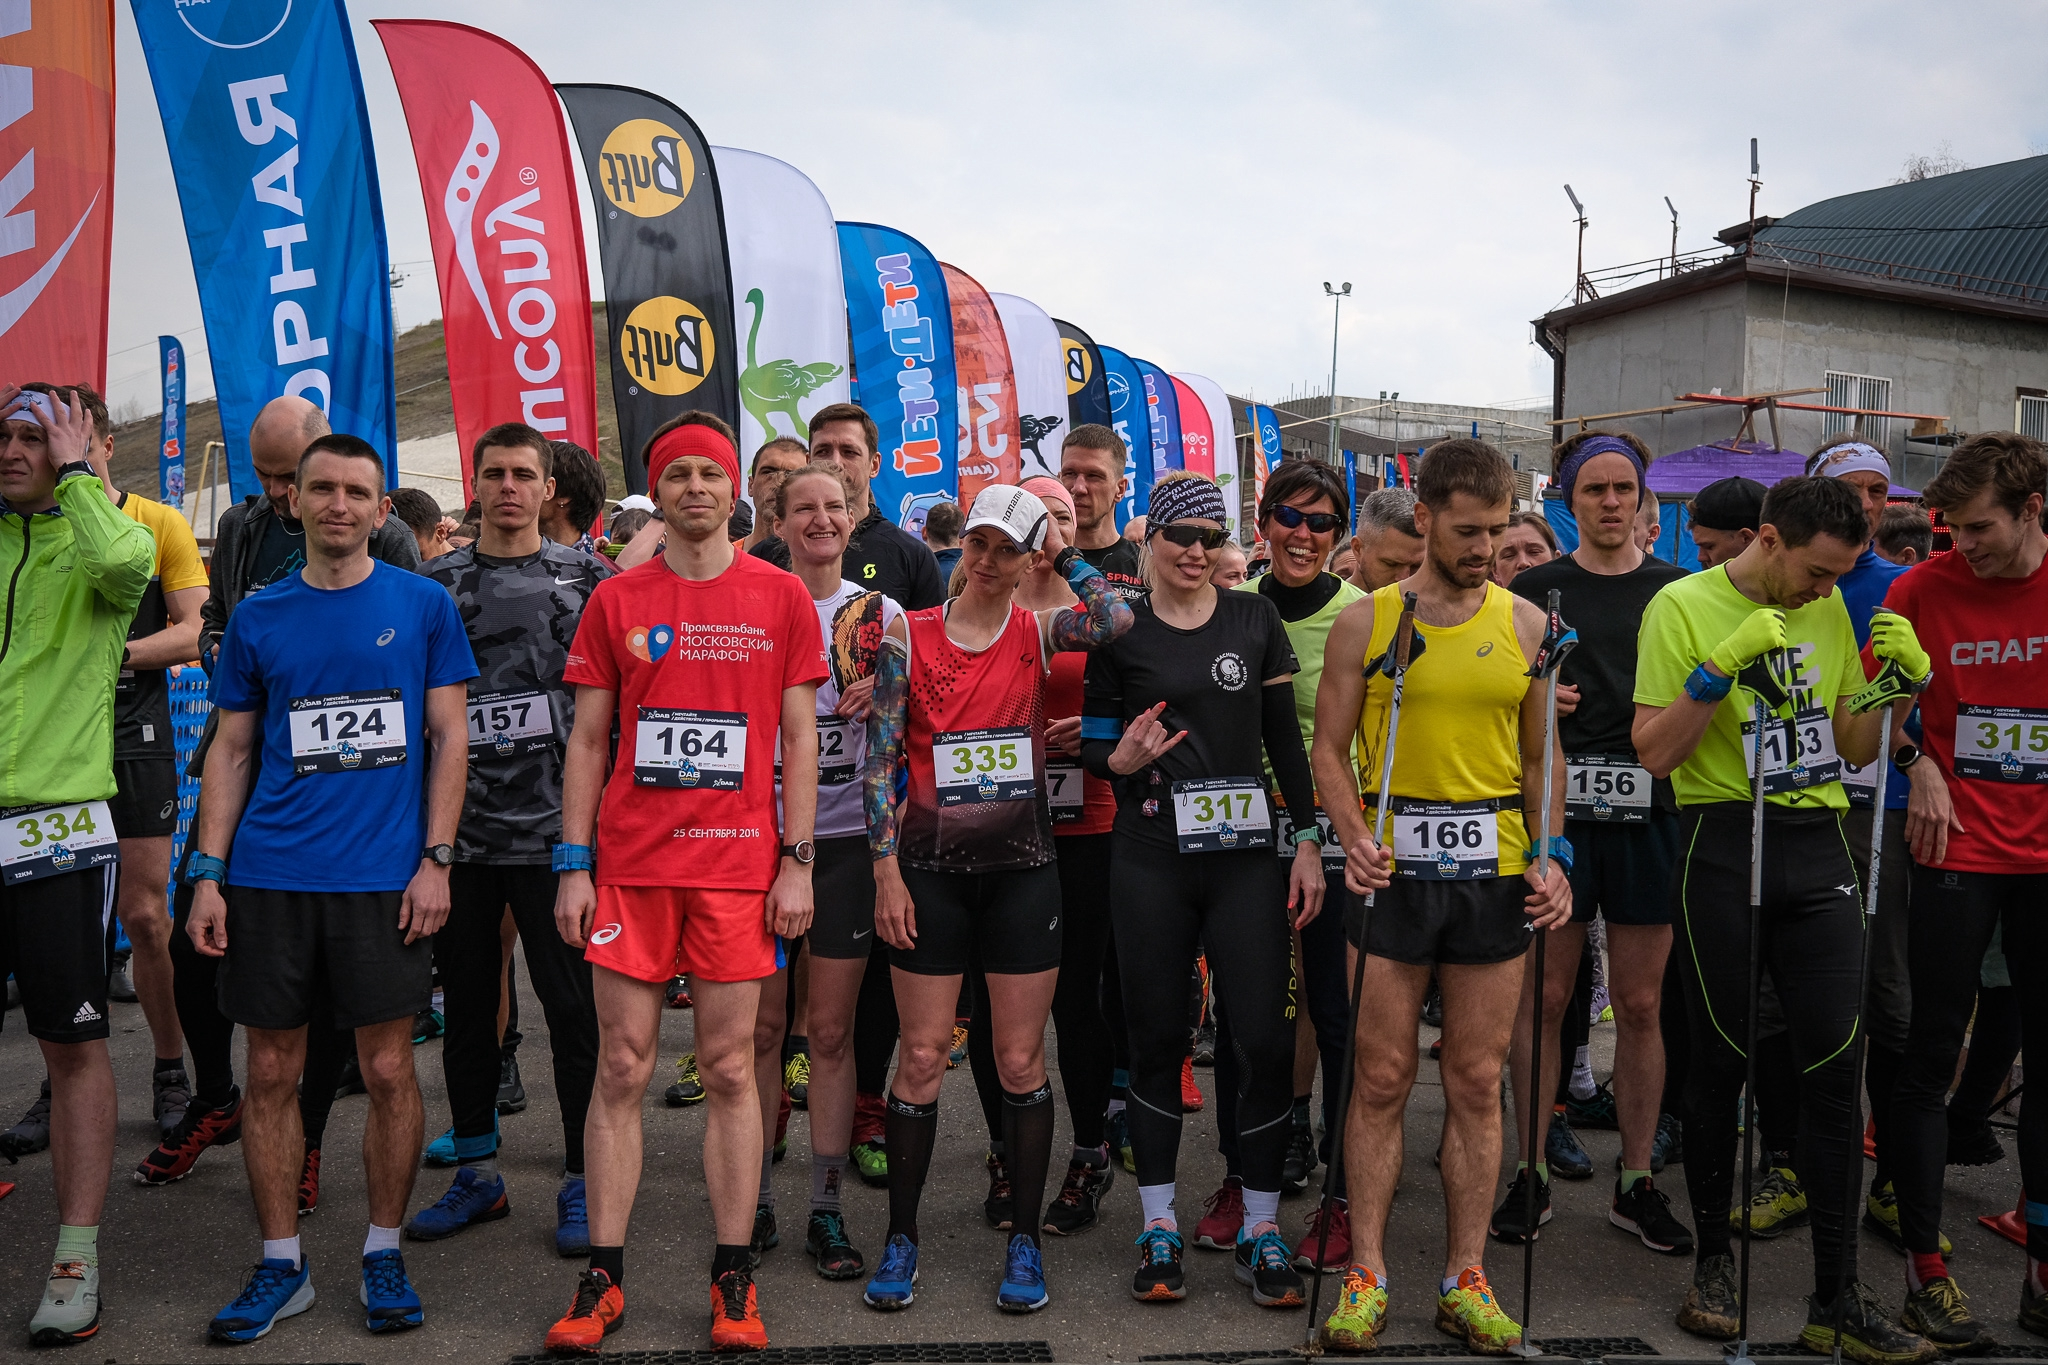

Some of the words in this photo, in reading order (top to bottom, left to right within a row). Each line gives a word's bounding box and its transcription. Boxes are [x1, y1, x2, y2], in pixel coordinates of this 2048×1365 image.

[228, 73, 331, 416] ОРНАЯ
[681, 621, 766, 636] Промсвязьбанк
[680, 634, 774, 653] МОСКОВСКИЙ
[680, 648, 749, 663] МАРАФОН
[311, 708, 386, 741] 124
[470, 702, 531, 733] 157
[656, 727, 728, 758] 164
[1976, 721, 2048, 752] 315
[339, 752, 362, 760] DAB
[952, 744, 1018, 774] 335
[1573, 770, 1635, 796] 156
[1193, 793, 1253, 822] 317
[16, 807, 97, 848] 334
[673, 828, 686, 839] 25
[688, 828, 737, 839] СЕНТЯБРЯ
[739, 827, 760, 838] 2016
[1413, 820, 1482, 849] 166
[52, 854, 76, 864] DAB
[15, 869, 33, 879] 12KM
[73, 1012, 102, 1024] adidas
